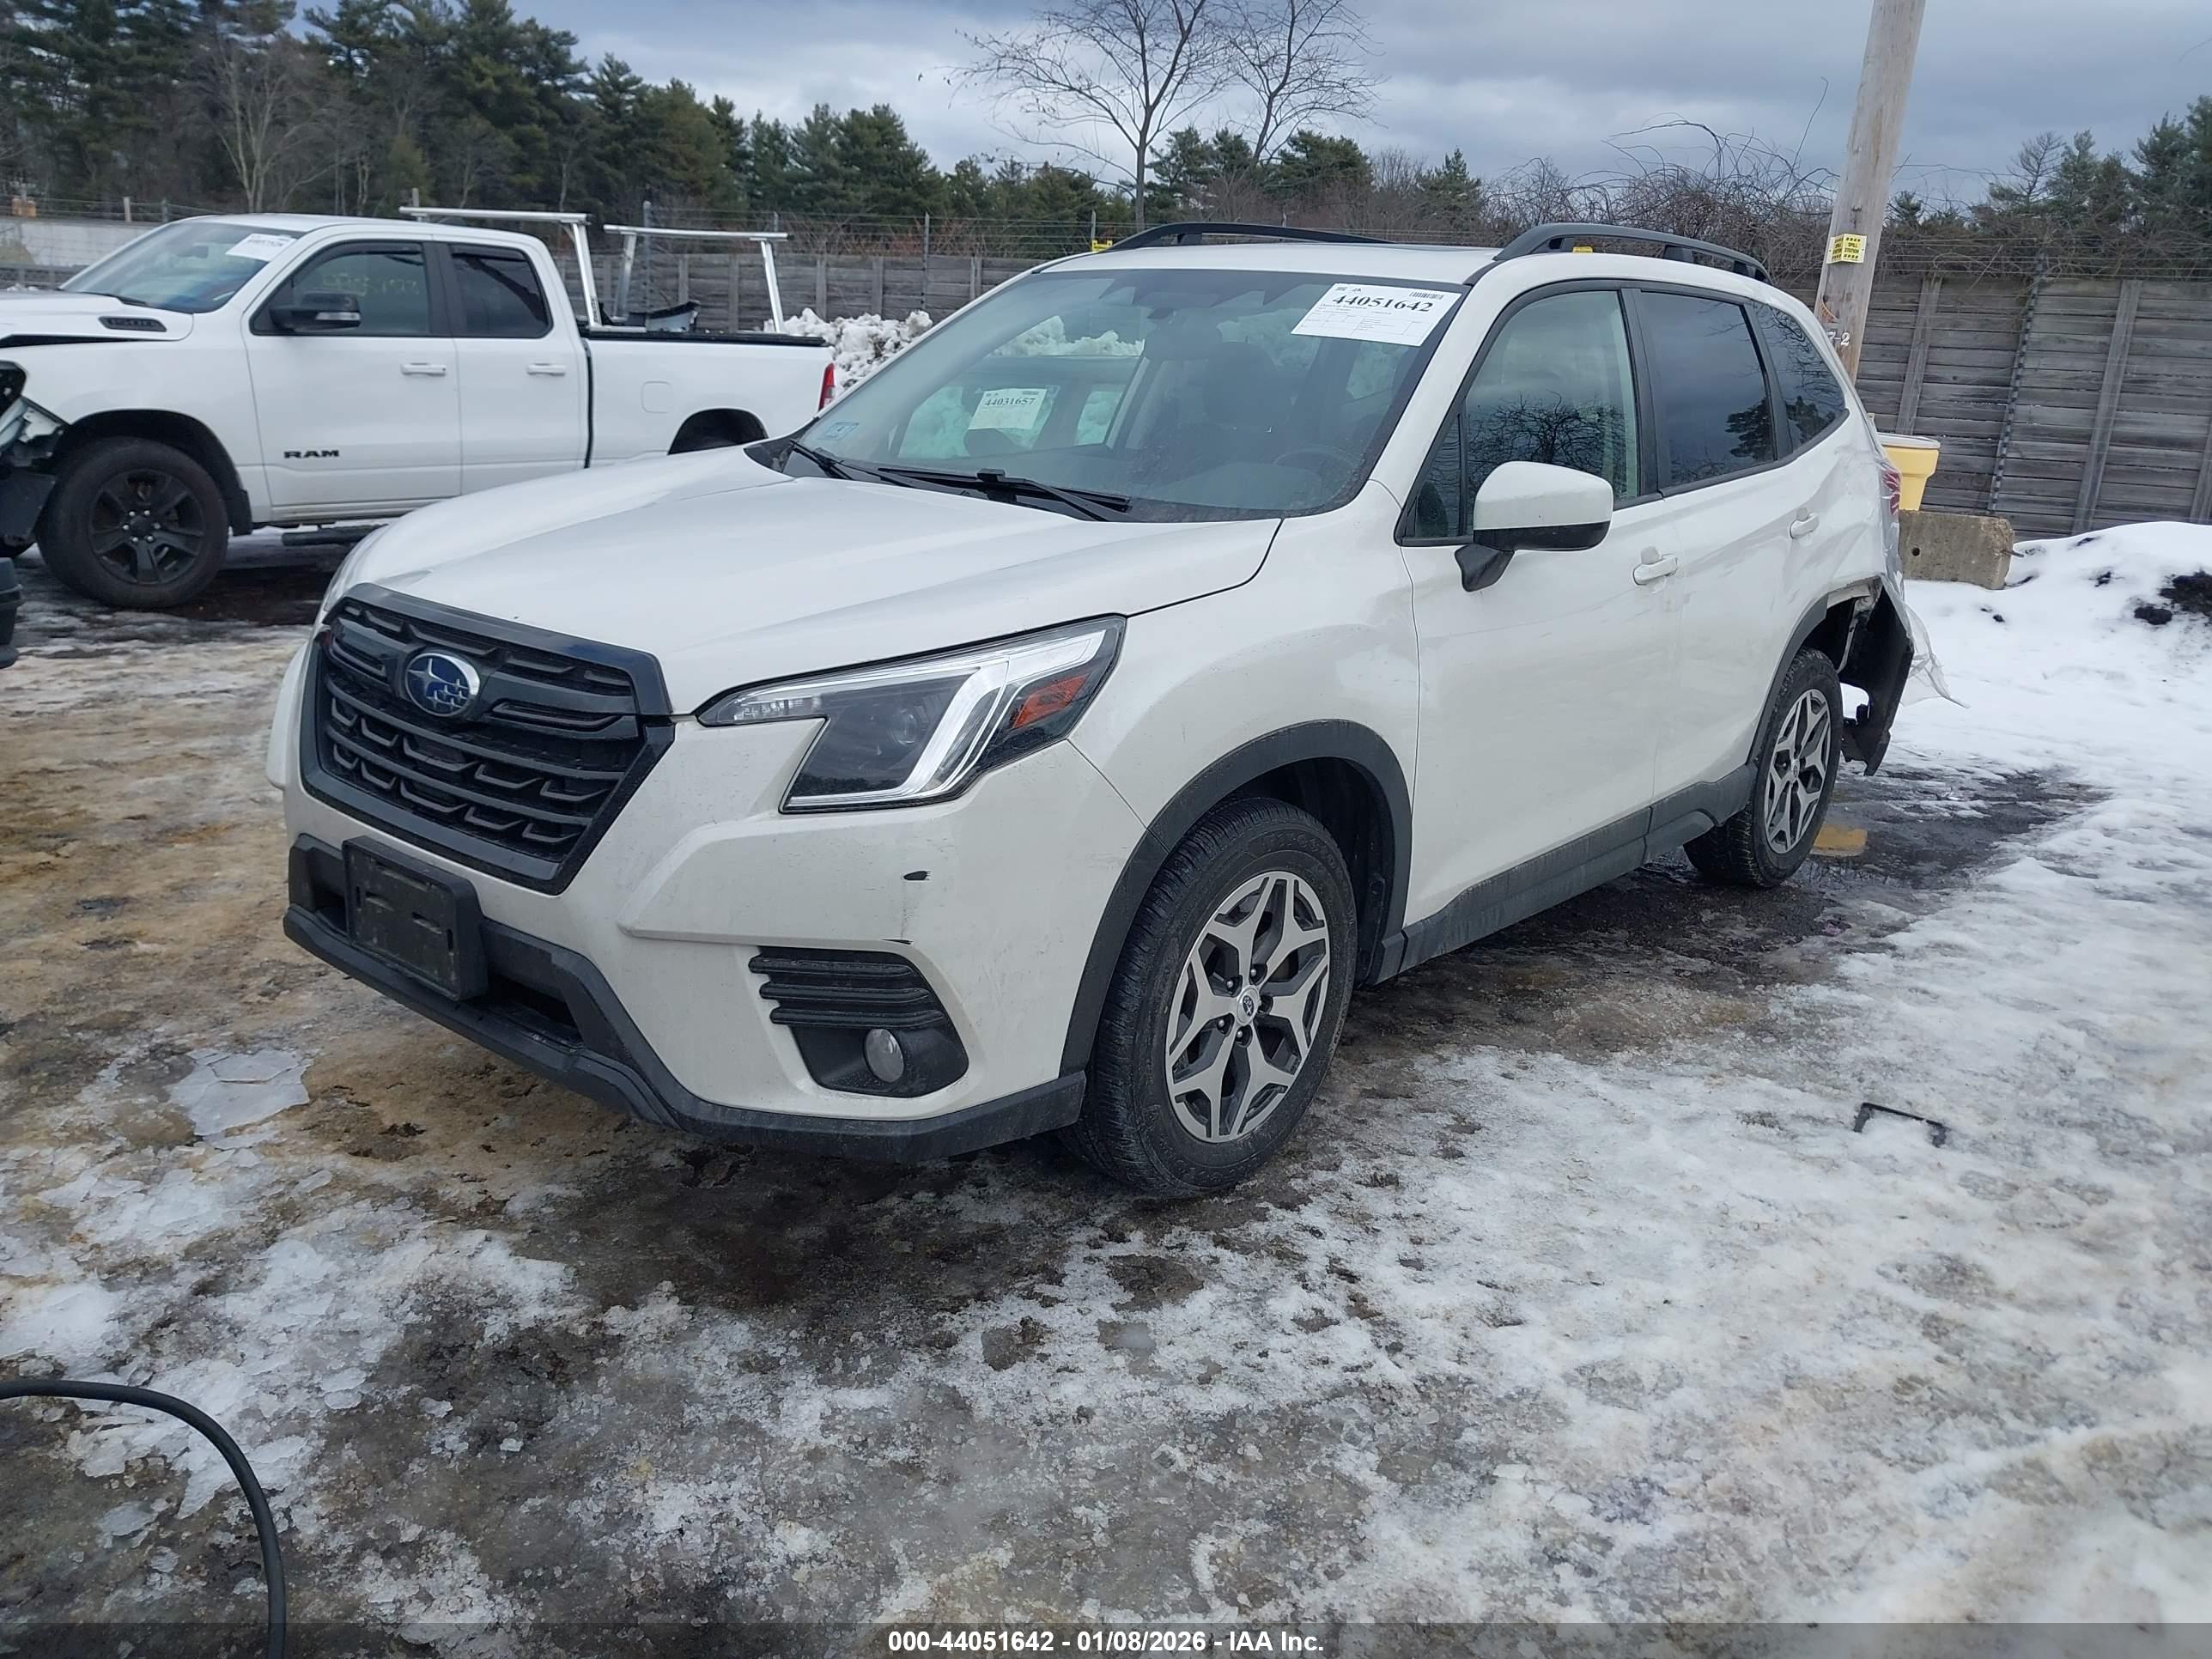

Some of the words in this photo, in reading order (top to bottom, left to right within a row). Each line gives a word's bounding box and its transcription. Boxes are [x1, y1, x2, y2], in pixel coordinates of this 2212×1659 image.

[1332, 295, 1434, 312] 44051642
[984, 398, 1036, 406] 44031657
[283, 449, 340, 459] RAM
